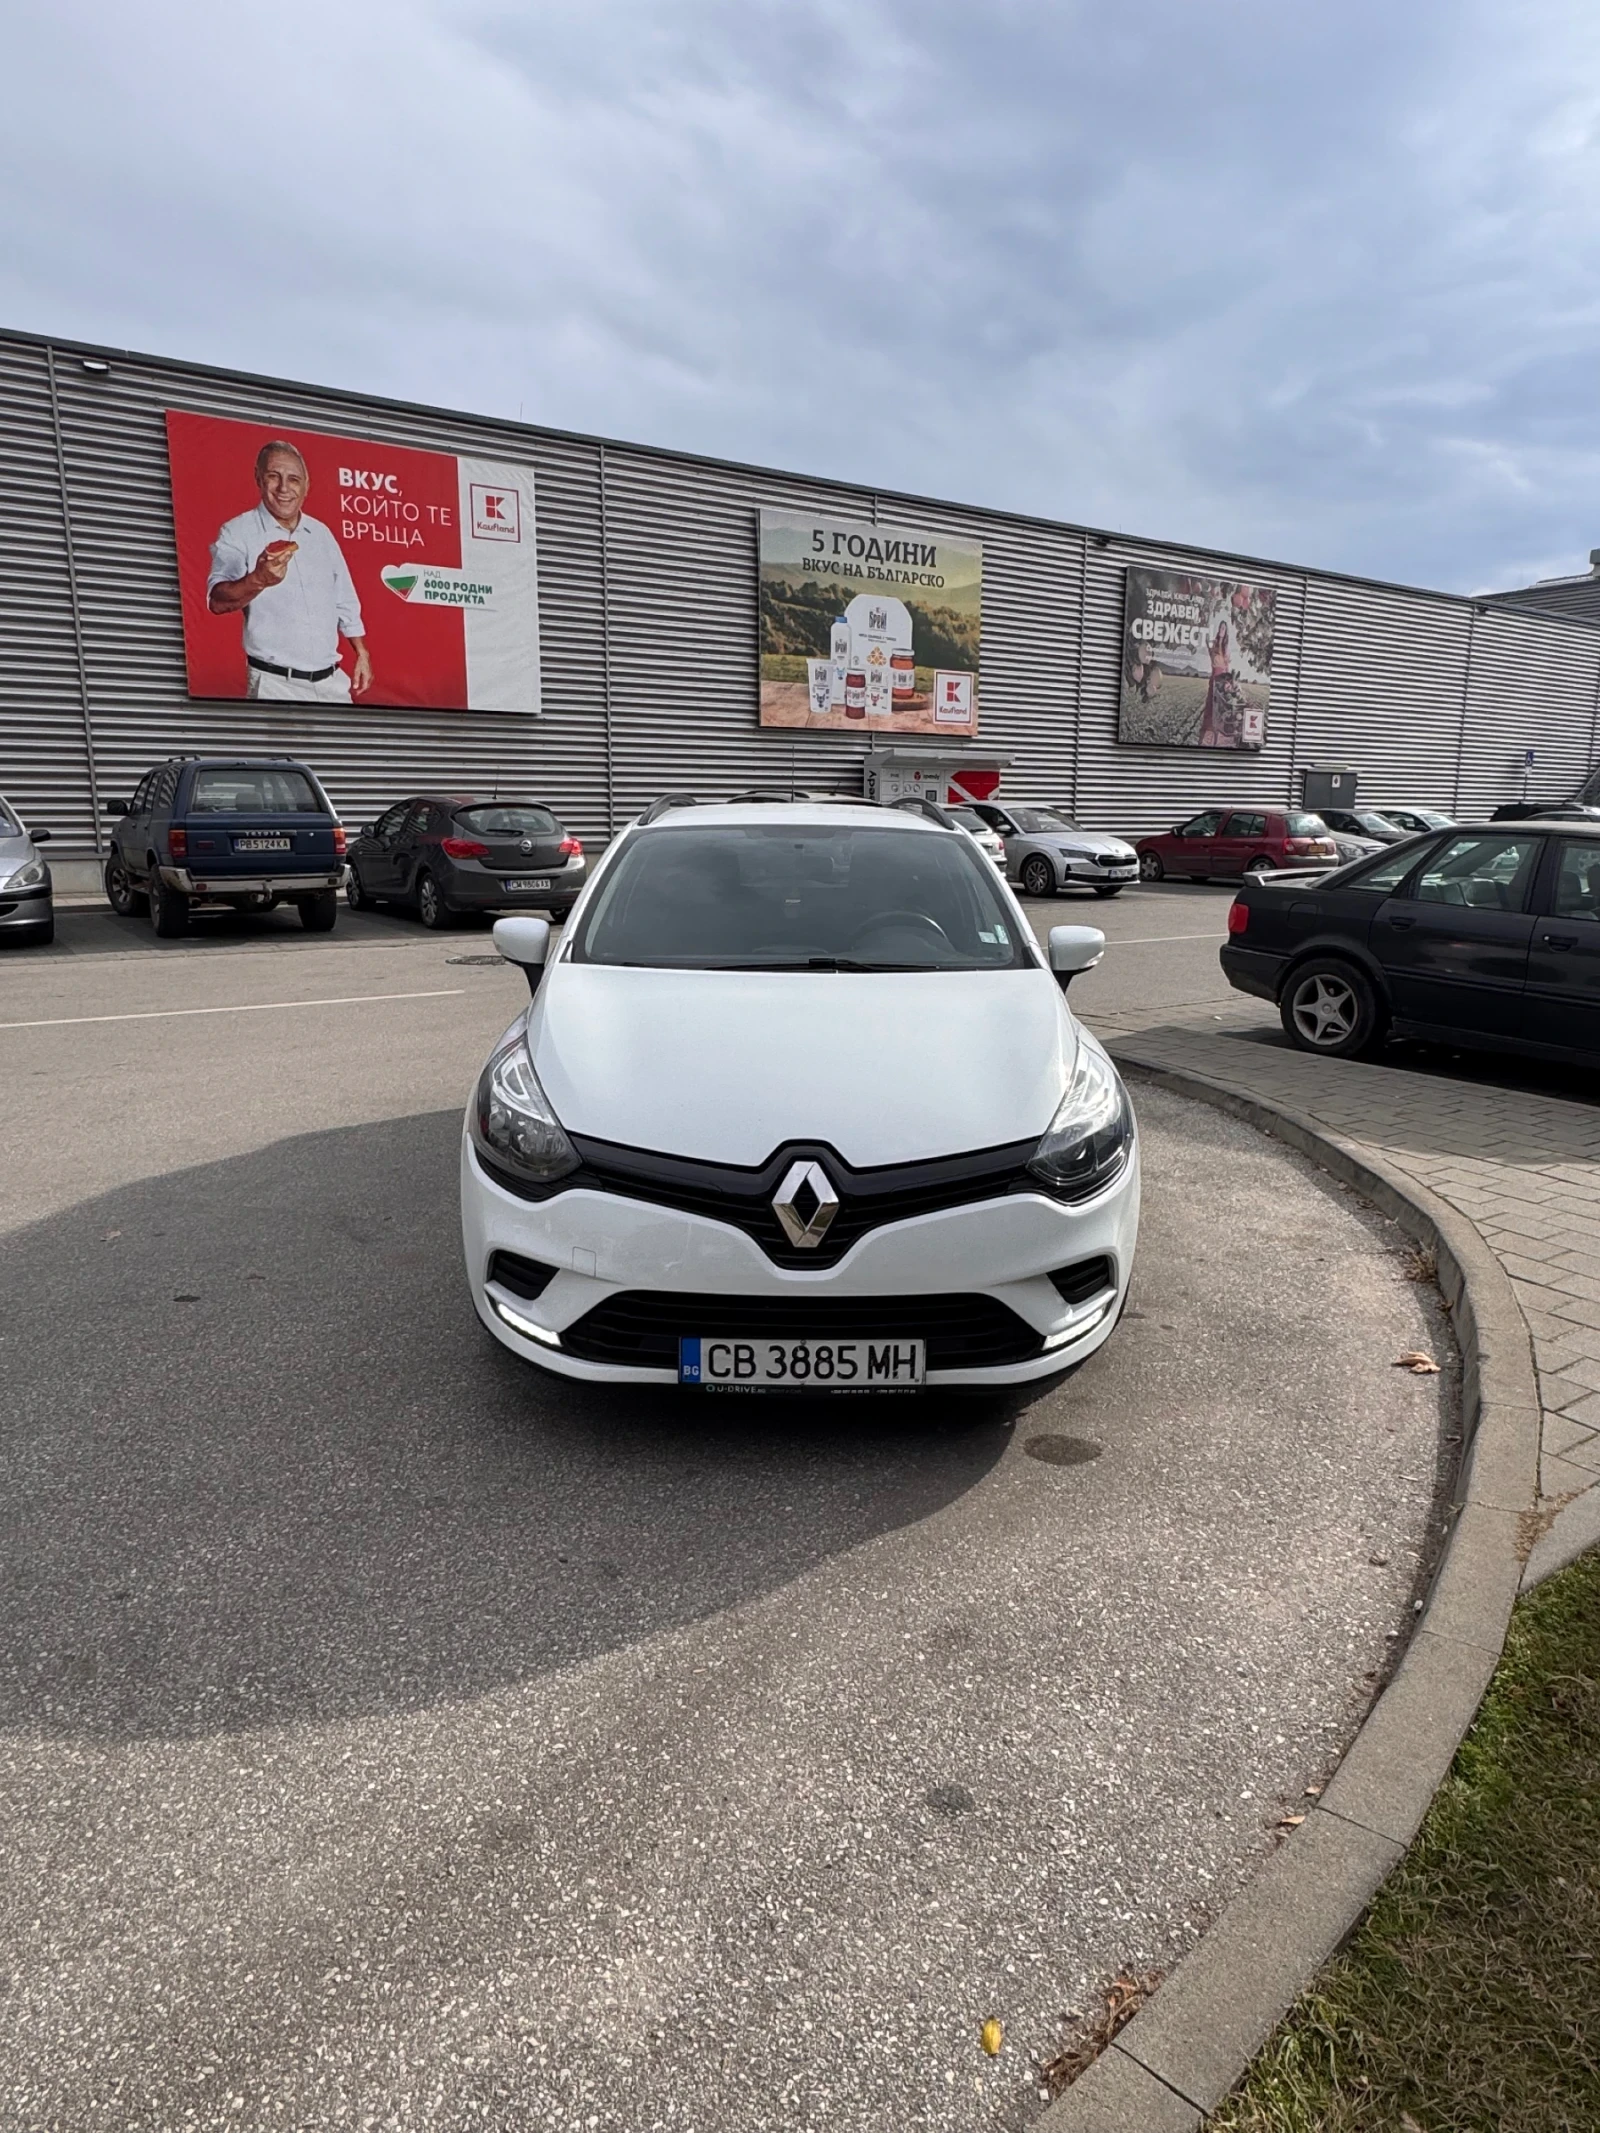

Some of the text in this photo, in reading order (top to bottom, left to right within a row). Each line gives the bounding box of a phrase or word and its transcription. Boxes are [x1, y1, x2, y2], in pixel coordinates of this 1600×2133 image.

[338, 467, 402, 496] ВКУС,
[340, 494, 452, 526] КОЙТО ТЕ
[342, 520, 425, 548] ВРЪЩА
[477, 521, 515, 534] Kaufland
[812, 529, 937, 568] 5 ГОДИНИ
[423, 569, 441, 579] НАД
[424, 579, 492, 594] 6000 РОДНИ
[802, 557, 945, 588] ВКУС НА БЪЛГАРСКО
[424, 590, 485, 604] ПРОДУКТА
[684, 1365, 699, 1376] BG
[766, 1345, 858, 1379] 3885
